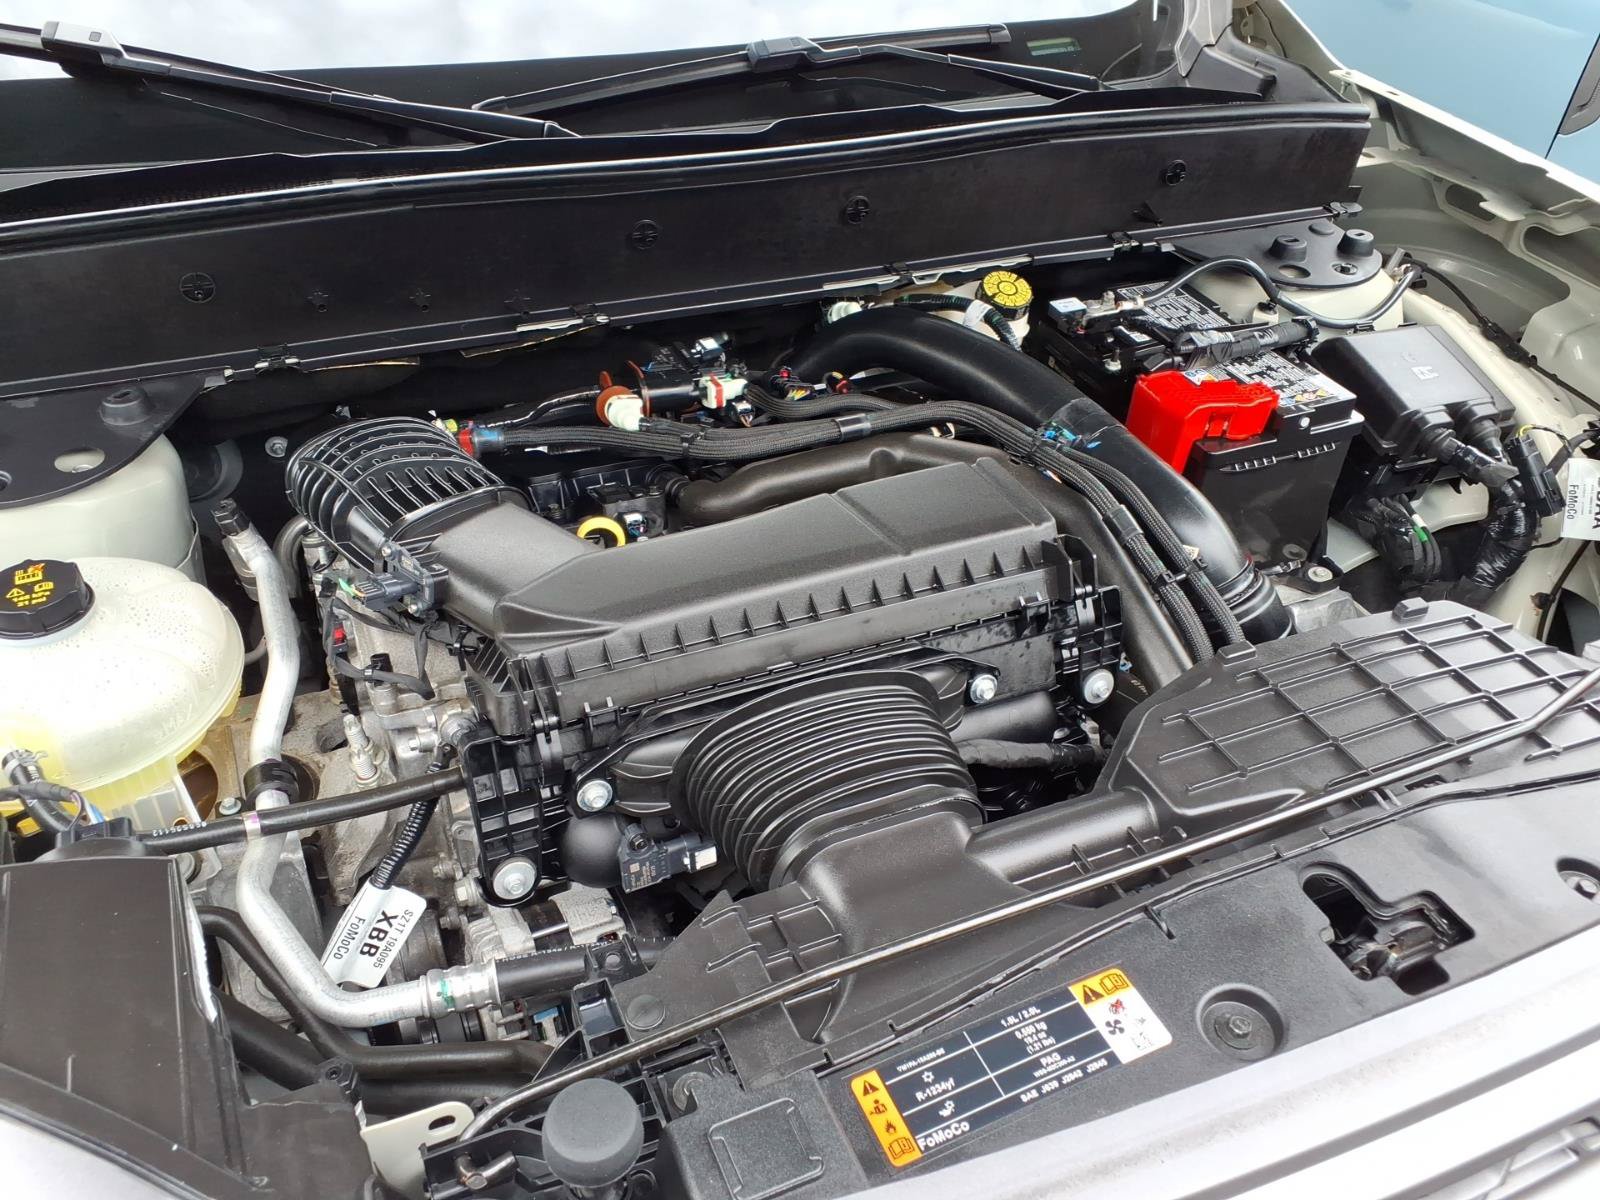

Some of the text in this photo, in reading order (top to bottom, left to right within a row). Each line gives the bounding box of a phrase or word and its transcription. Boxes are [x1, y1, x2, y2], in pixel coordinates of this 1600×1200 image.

[1567, 484, 1579, 520] FoMoCo
[334, 916, 365, 960] FoMoCo
[360, 910, 398, 957] XBB
[374, 909, 413, 968] SZ1T 19A095
[1039, 1052, 1061, 1068] PAG
[915, 1077, 956, 1102] R-1234yf
[918, 1121, 970, 1150] FoMoCo
